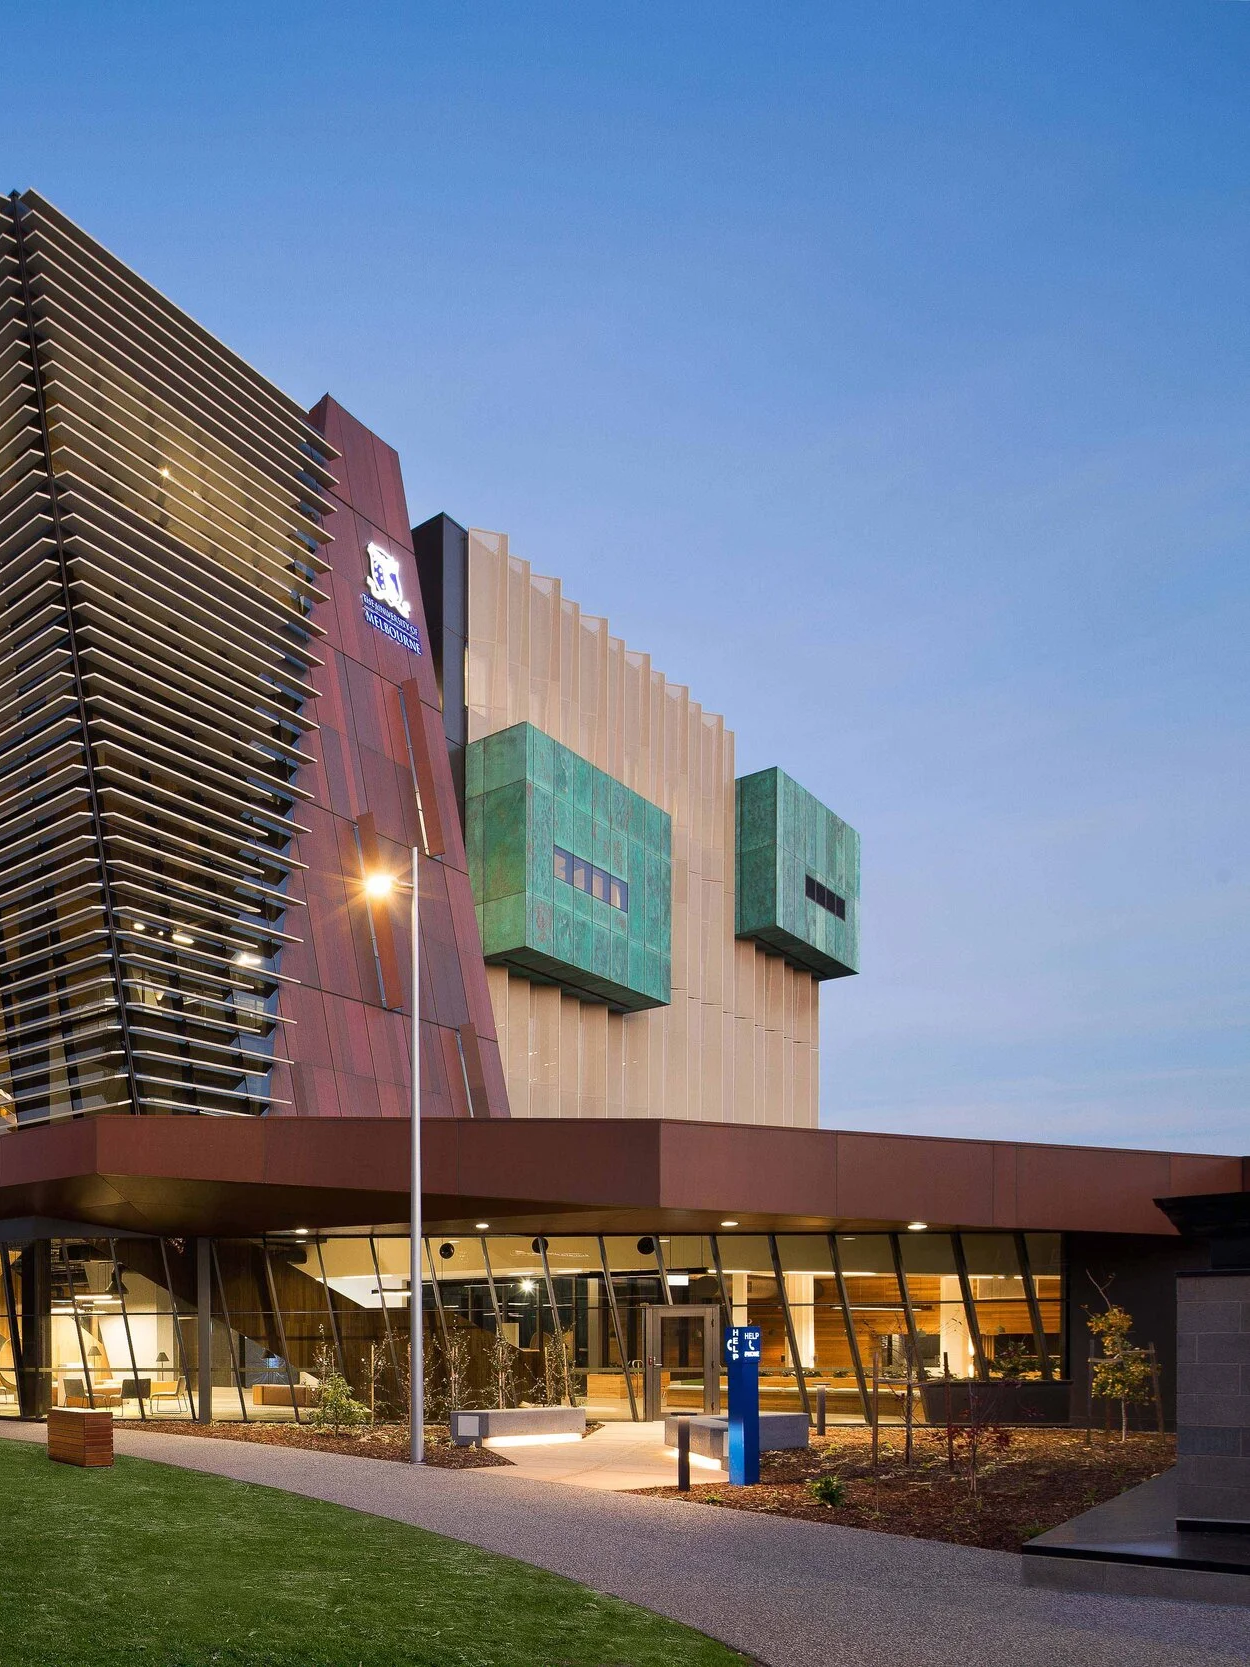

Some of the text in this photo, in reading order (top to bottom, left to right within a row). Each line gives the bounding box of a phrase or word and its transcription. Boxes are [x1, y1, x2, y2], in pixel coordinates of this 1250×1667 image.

[362, 593, 374, 607] THE
[375, 602, 410, 631] UNIVERSITY
[365, 611, 422, 655] MELBOURNE
[744, 1332, 760, 1340] HELP
